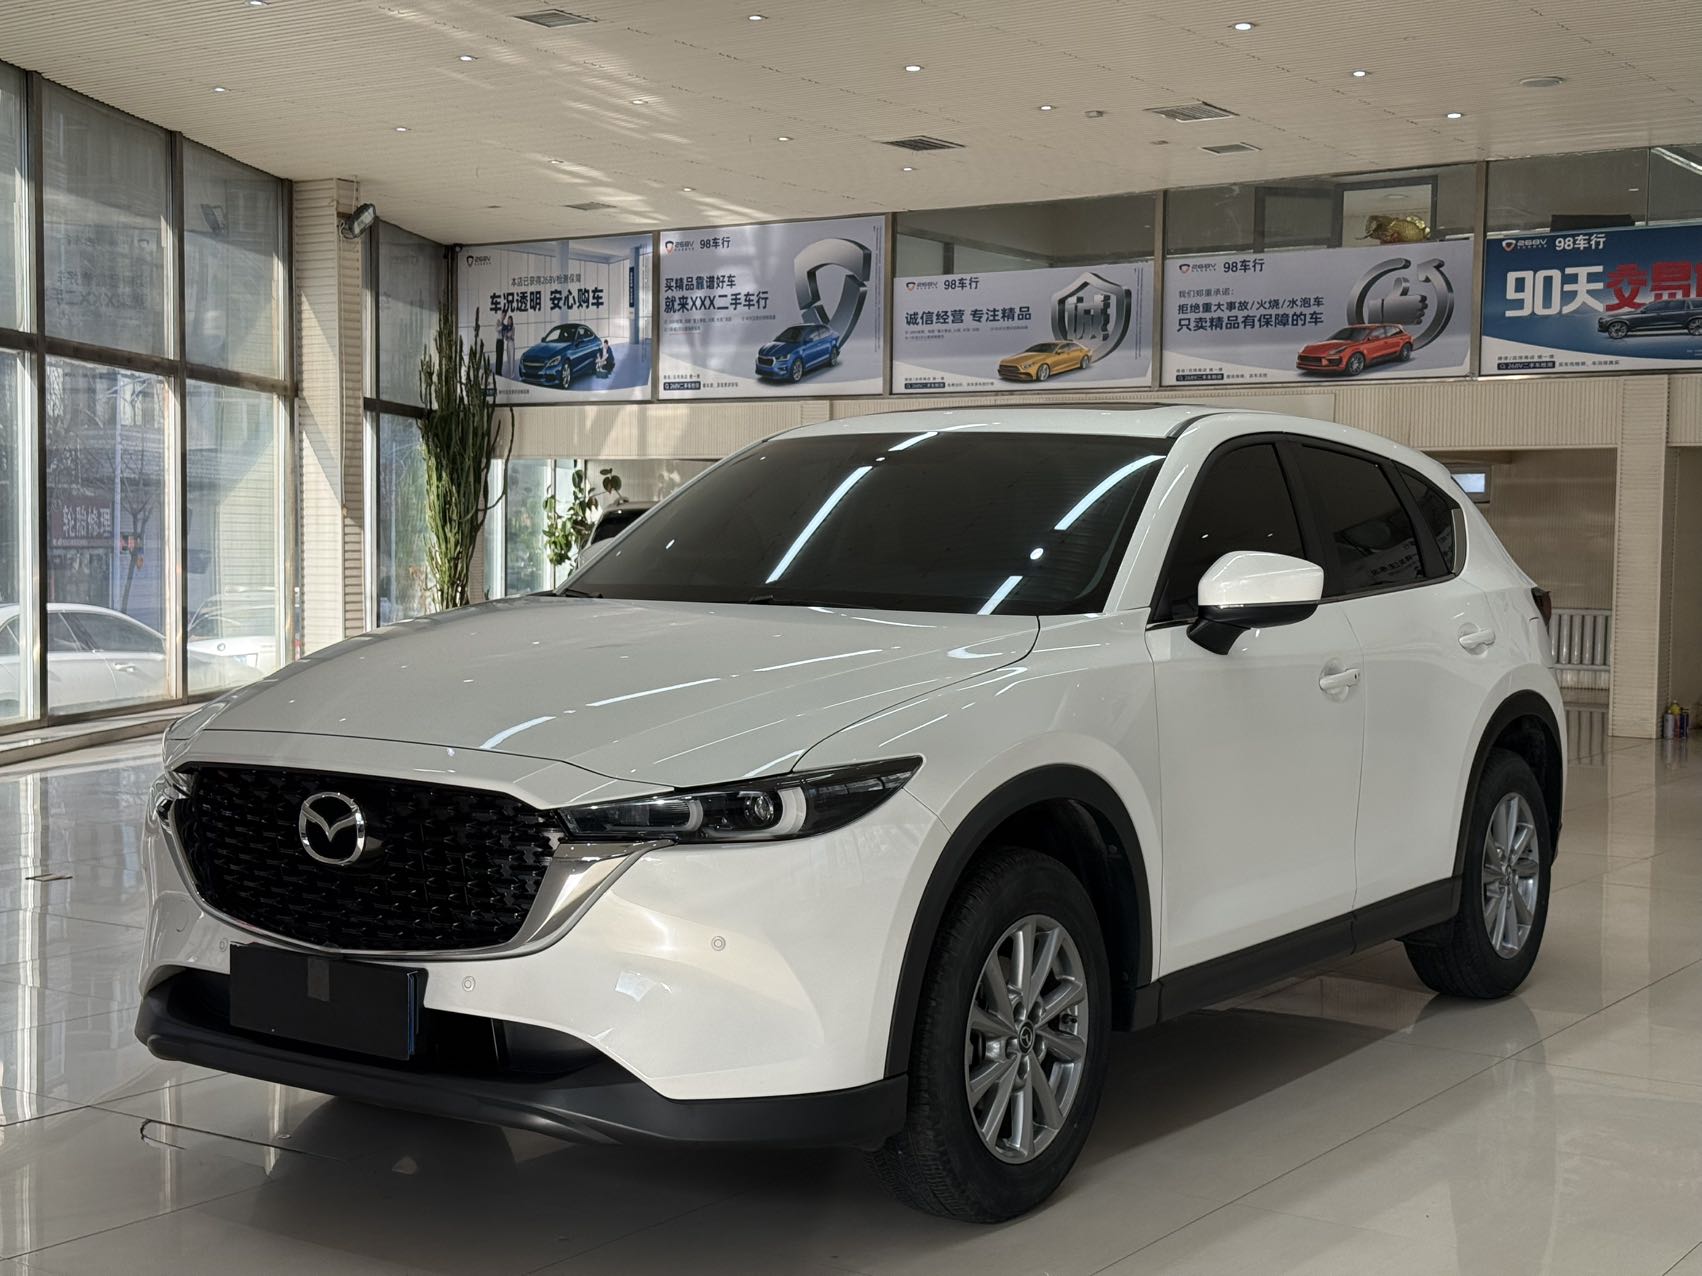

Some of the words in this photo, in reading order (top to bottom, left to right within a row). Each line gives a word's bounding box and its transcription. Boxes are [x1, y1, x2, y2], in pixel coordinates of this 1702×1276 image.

[699, 236, 731, 250] 98车行
[1555, 234, 1606, 251] 98车行
[1223, 258, 1265, 273] 98车行
[664, 274, 736, 292] 买精品靠谱好车
[943, 277, 980, 291] 98车行
[1505, 261, 1702, 317] 90天交易
[489, 290, 542, 314] 车况透明
[549, 287, 604, 311] 安心购车
[664, 291, 769, 314] 就来XXX二手车行
[1177, 296, 1325, 315] 拒绝重大事故/火烧/水泡车
[905, 309, 965, 326] 诚信经营
[970, 306, 1032, 323] 专注精品
[1177, 311, 1324, 333] 只卖精品有保障的车
